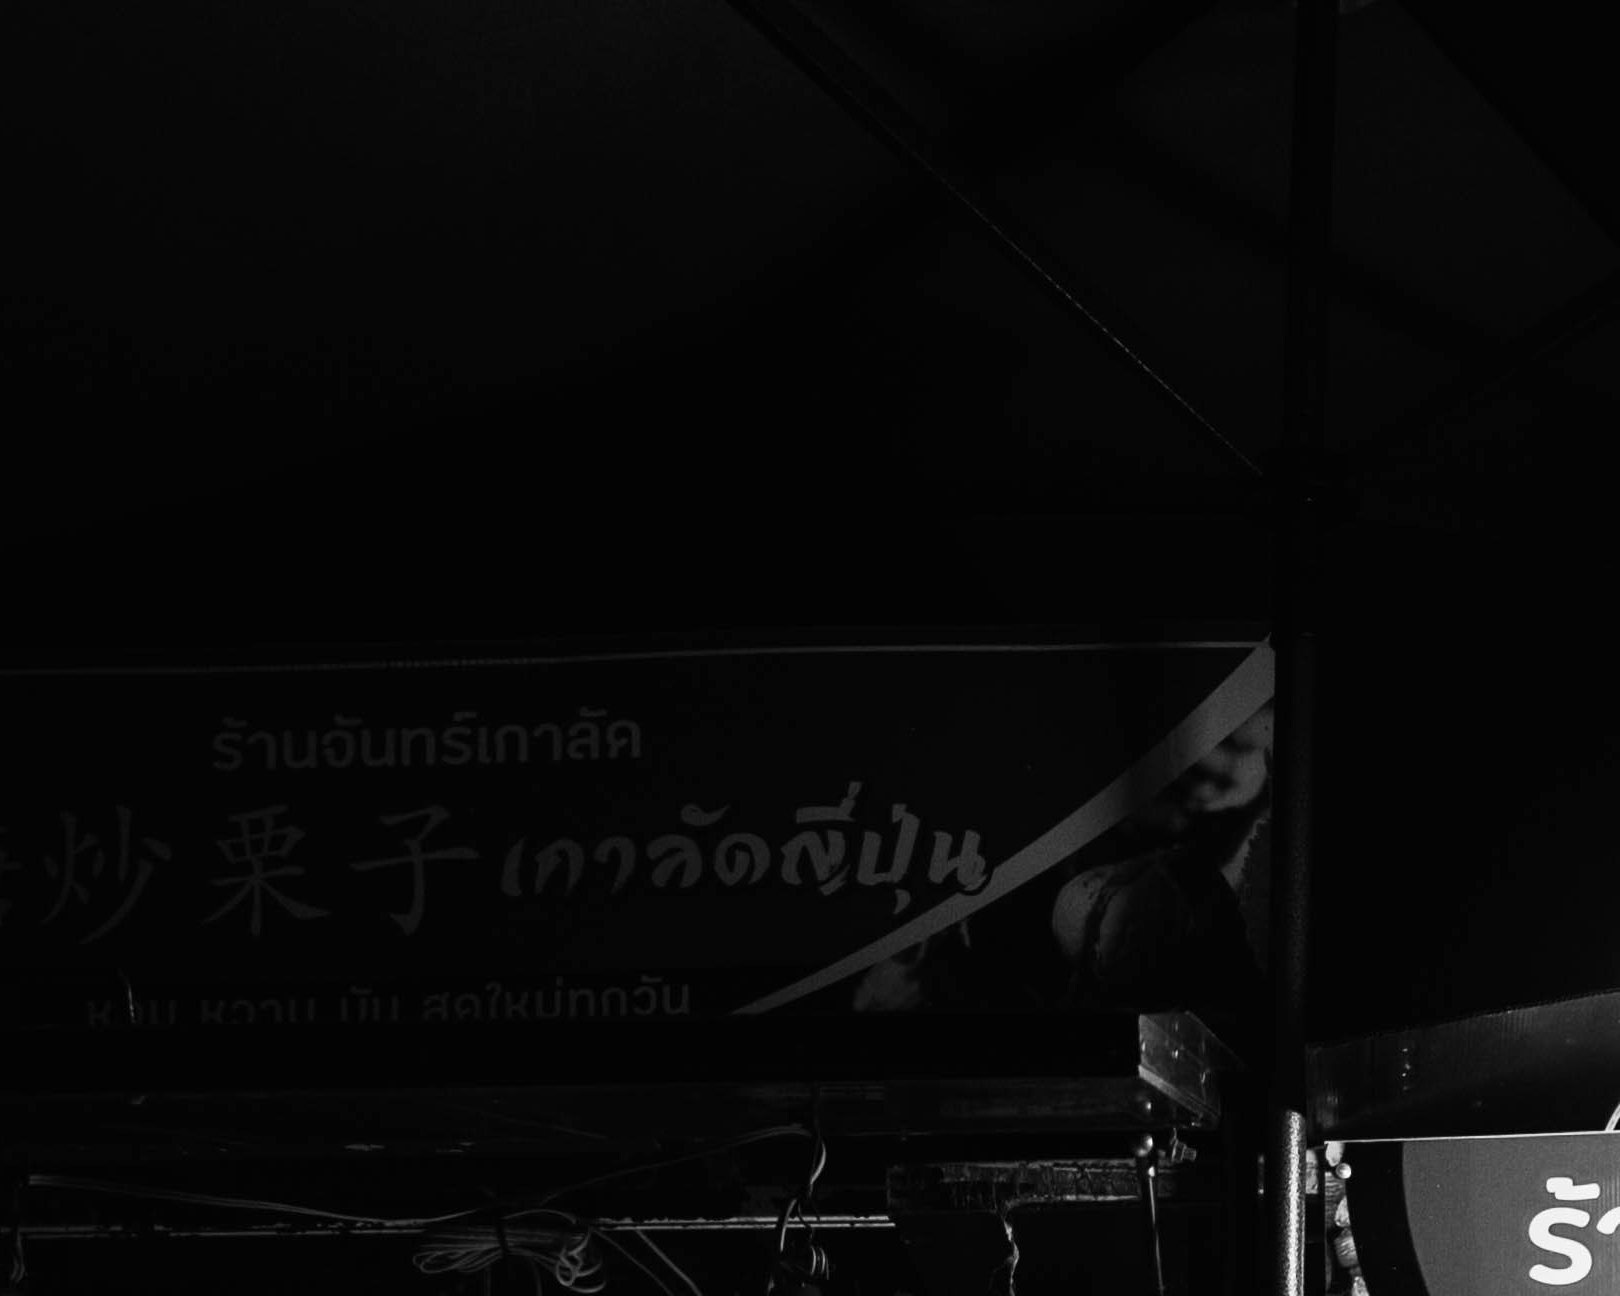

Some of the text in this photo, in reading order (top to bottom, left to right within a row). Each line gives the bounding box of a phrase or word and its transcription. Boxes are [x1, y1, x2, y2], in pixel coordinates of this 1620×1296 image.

[211, 706, 645, 773] ร้านจันทร์เกาลัด
[499, 779, 994, 913] เกาลัดญี่ปุ่น
